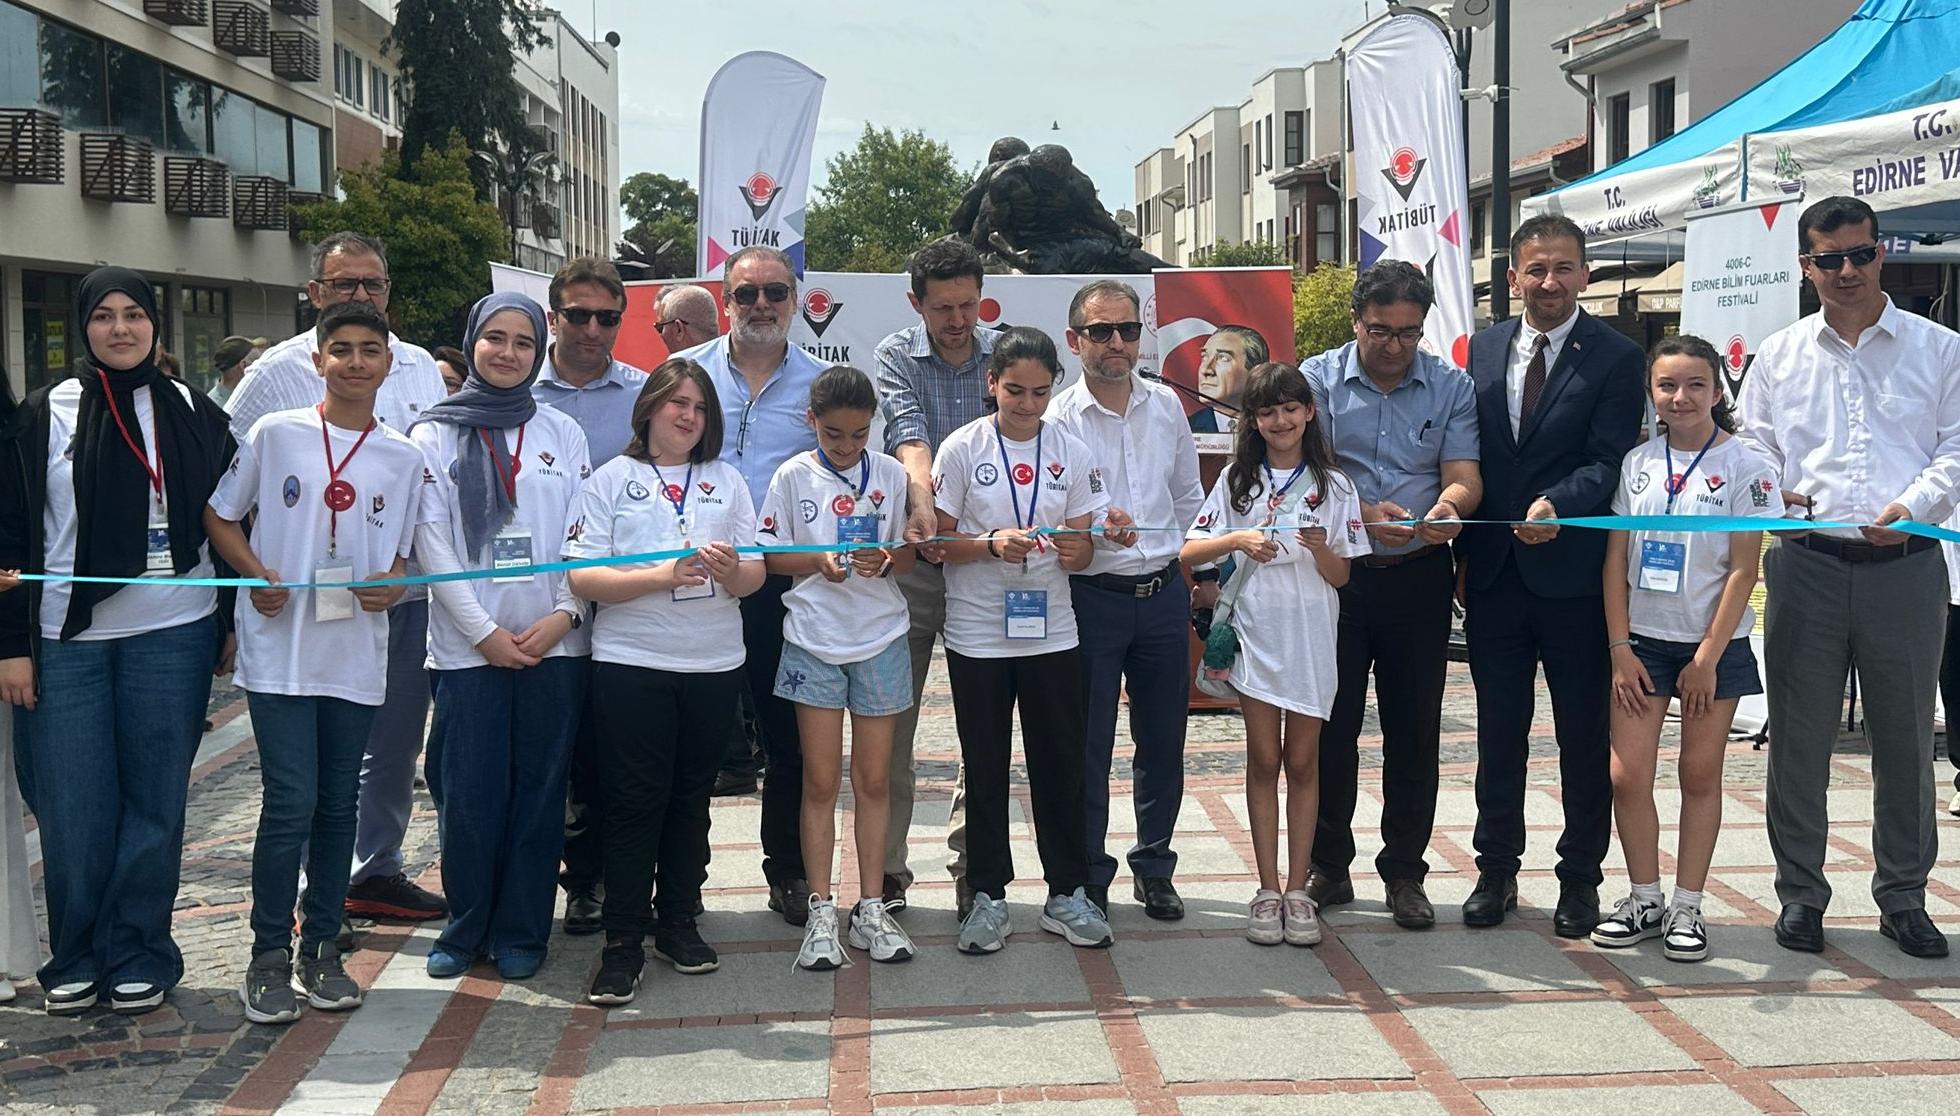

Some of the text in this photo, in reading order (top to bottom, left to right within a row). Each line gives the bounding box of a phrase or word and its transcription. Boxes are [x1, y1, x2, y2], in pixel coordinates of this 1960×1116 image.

[1913, 109, 1952, 140] T.C.
[1853, 158, 1926, 196] EDİRNE
[1725, 256, 1751, 270] 4006-C
[1691, 270, 1790, 292] EDİRNE BİLİM FUARLARI
[1717, 290, 1758, 307] FESTİVALİ
[1696, 493, 1723, 507] TÜBİTAK
